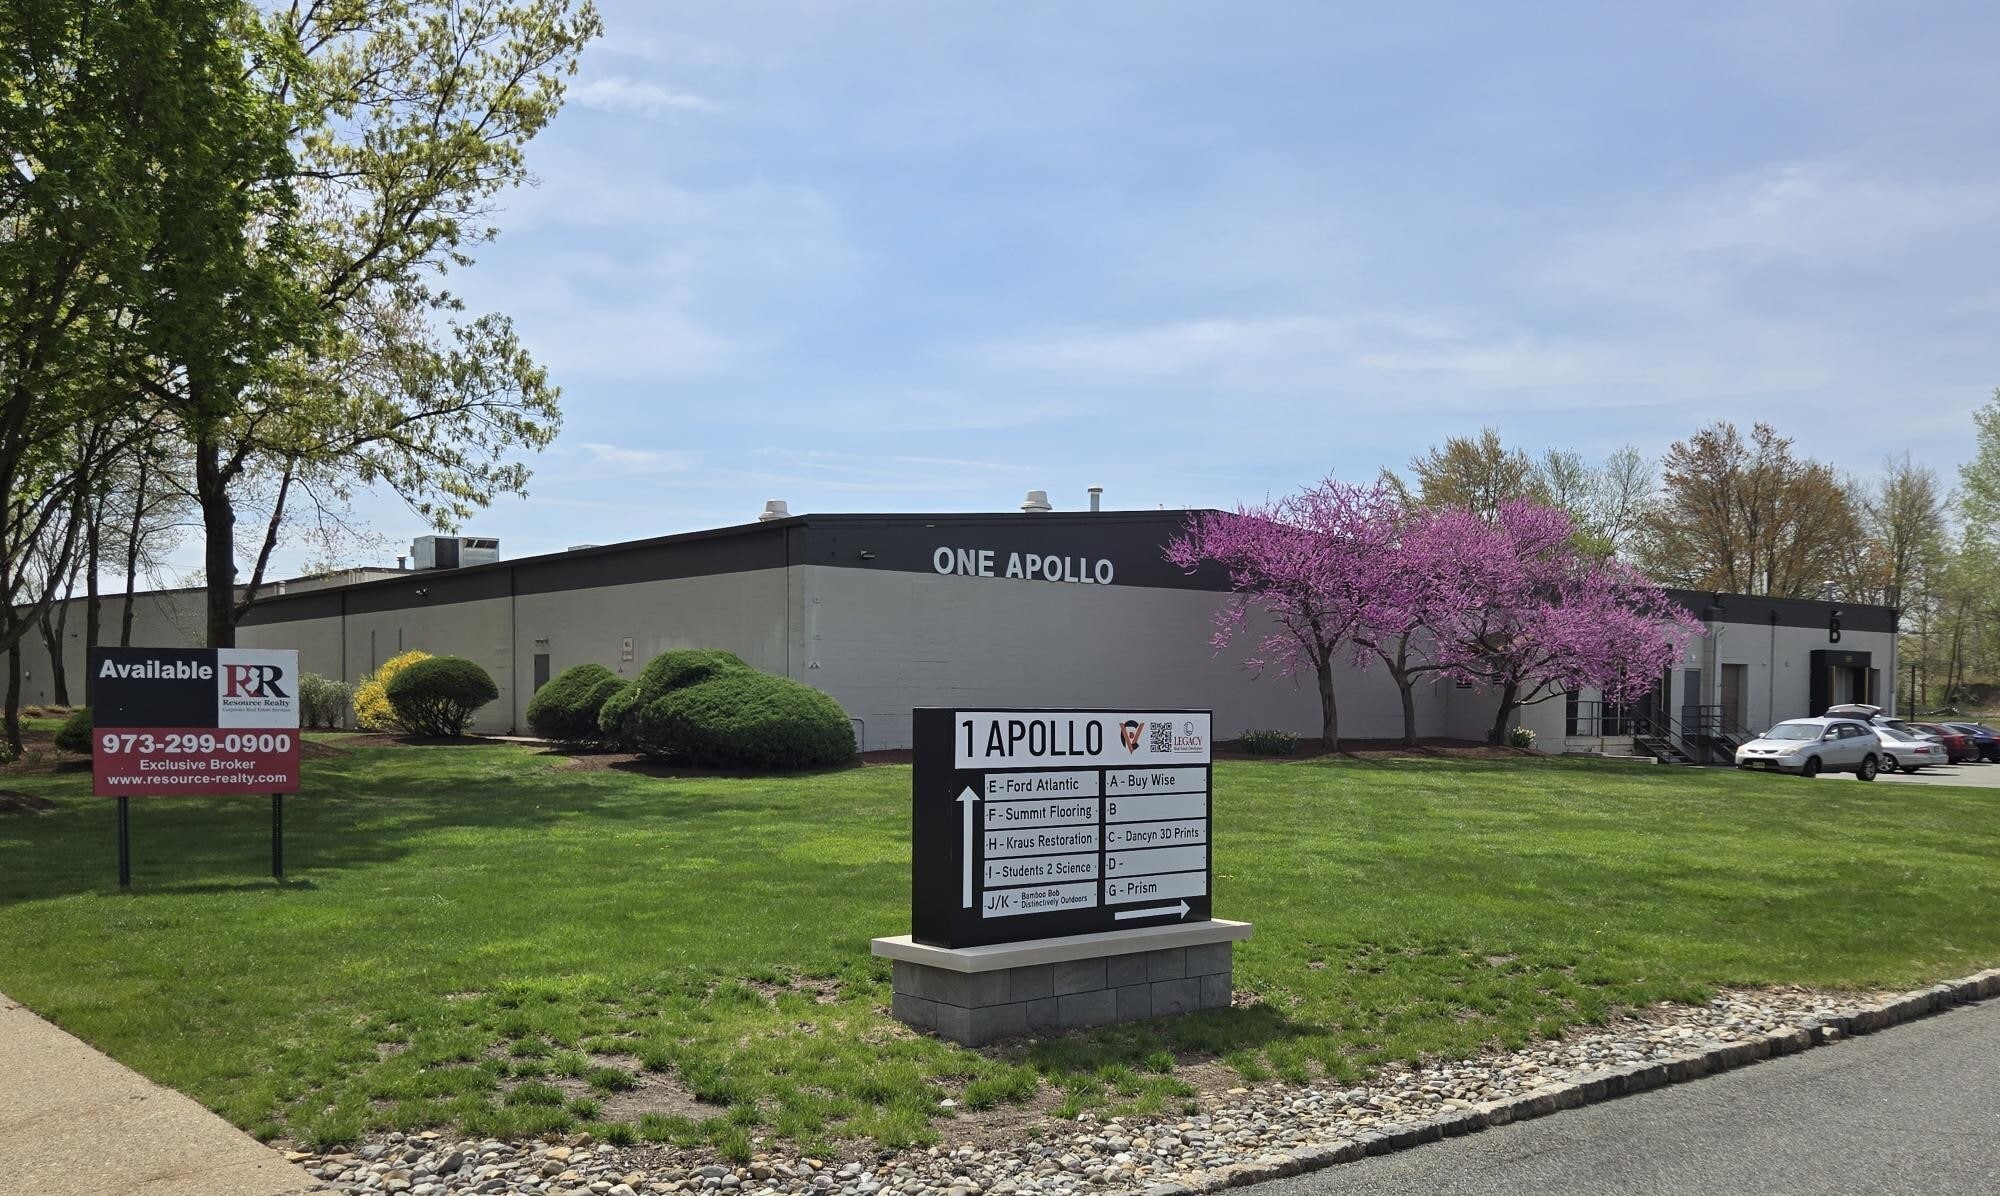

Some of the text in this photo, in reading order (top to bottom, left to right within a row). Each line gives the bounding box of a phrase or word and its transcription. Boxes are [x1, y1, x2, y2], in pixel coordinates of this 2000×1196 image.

[933, 546, 1114, 585] ONE APOLLO
[1829, 618, 1841, 643] B
[99, 659, 213, 680] Available
[264, 699, 290, 708] Realty
[102, 734, 291, 754] 973-299-0900
[962, 719, 1103, 758] 1 APOLLO
[1174, 736, 1202, 746] LEGACY
[140, 759, 256, 771] Exclusive Broker
[107, 773, 287, 785] www.resource-realty.com
[989, 780, 997, 793] E
[1006, 779, 1032, 792] Ford
[1036, 777, 1079, 791] Atlantic
[1110, 775, 1118, 787] A
[1128, 774, 1147, 789] Buy
[1151, 773, 1176, 786] Wise
[988, 808, 996, 821] F
[1005, 807, 1046, 820] Summit
[1050, 804, 1092, 819] Flooring
[1109, 803, 1117, 815] B
[988, 837, 997, 850] H
[1006, 837, 1035, 849] Kraus
[1038, 832, 1092, 847] Restoration
[1108, 832, 1115, 843] C
[1126, 830, 1157, 843] Dancyn
[1160, 828, 1172, 840] 3D
[1174, 827, 1199, 839] Prints
[988, 866, 992, 878] I
[1002, 865, 1044, 878] Students
[1047, 863, 1053, 875] 2
[1056, 862, 1091, 874] Science
[1108, 858, 1116, 870] D
[1021, 889, 1060, 900] Bamboo Bob
[1108, 884, 1117, 896] G
[1127, 882, 1157, 894] Prism
[987, 894, 1009, 910] J/K
[1021, 895, 1088, 908] Distinctively Outdoors
